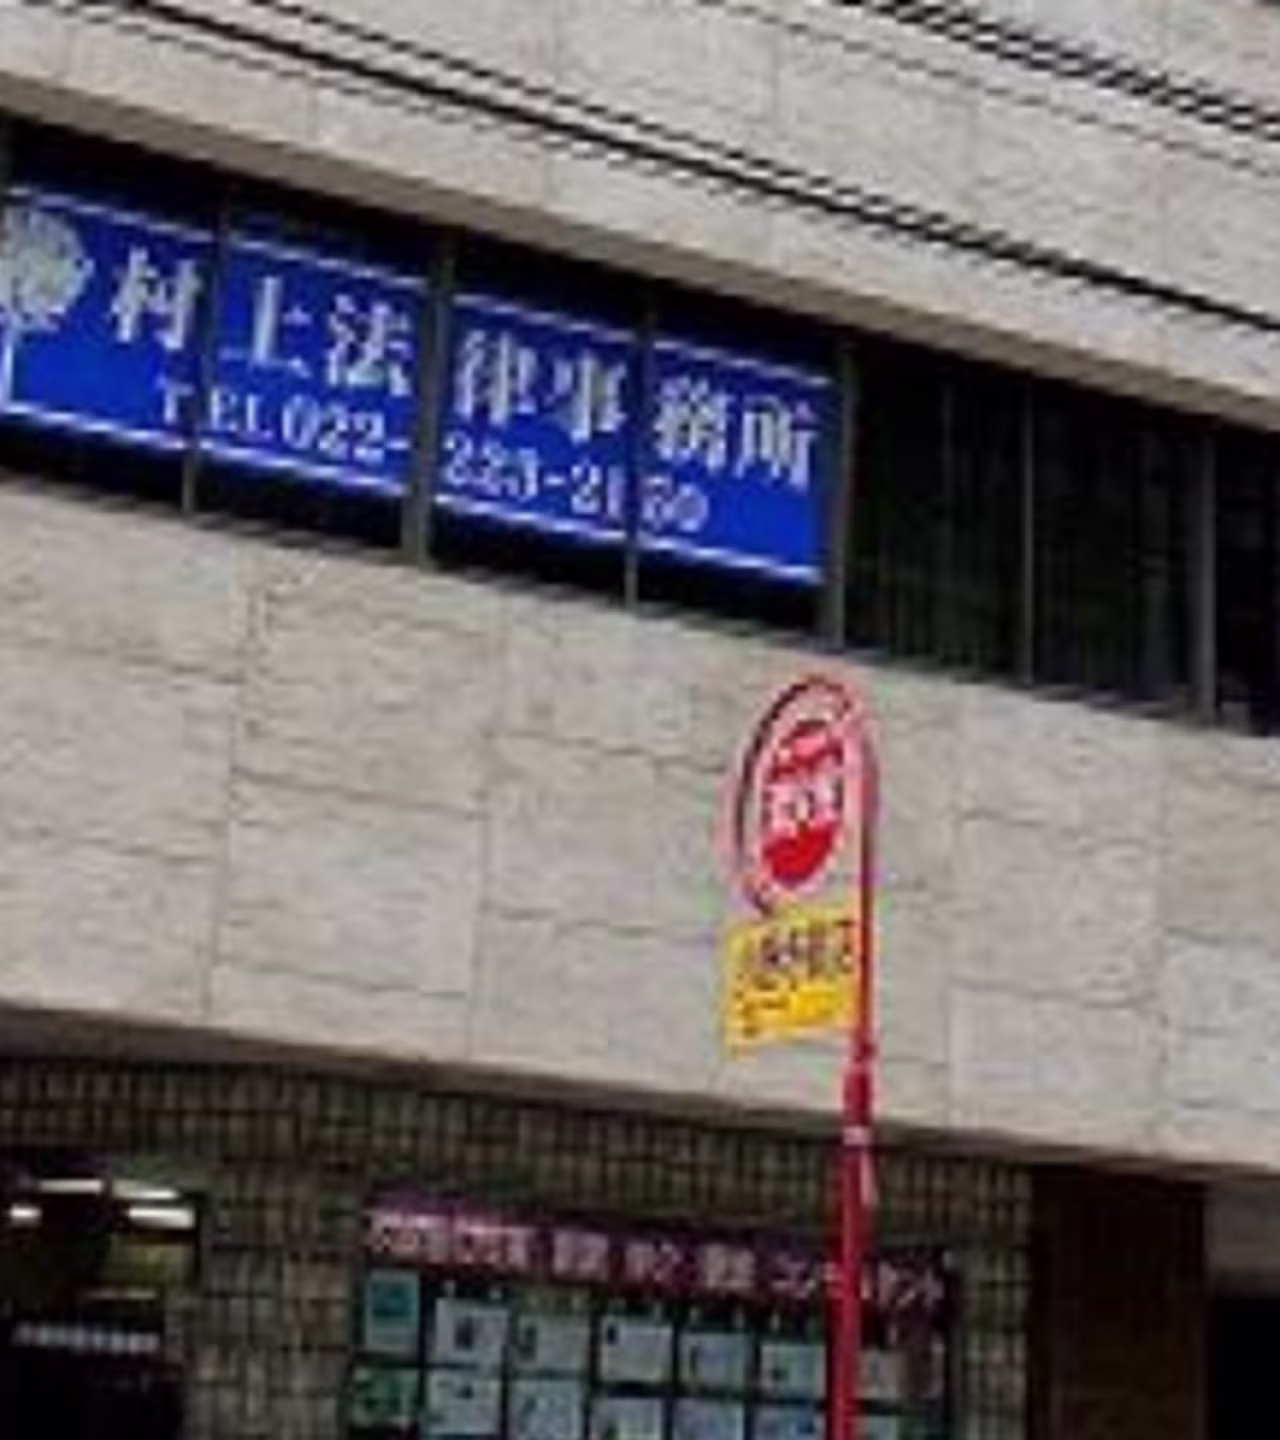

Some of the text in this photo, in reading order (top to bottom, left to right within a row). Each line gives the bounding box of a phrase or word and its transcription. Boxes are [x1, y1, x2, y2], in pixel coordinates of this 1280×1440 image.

[110, 243, 818, 491] 村上法律事務所
